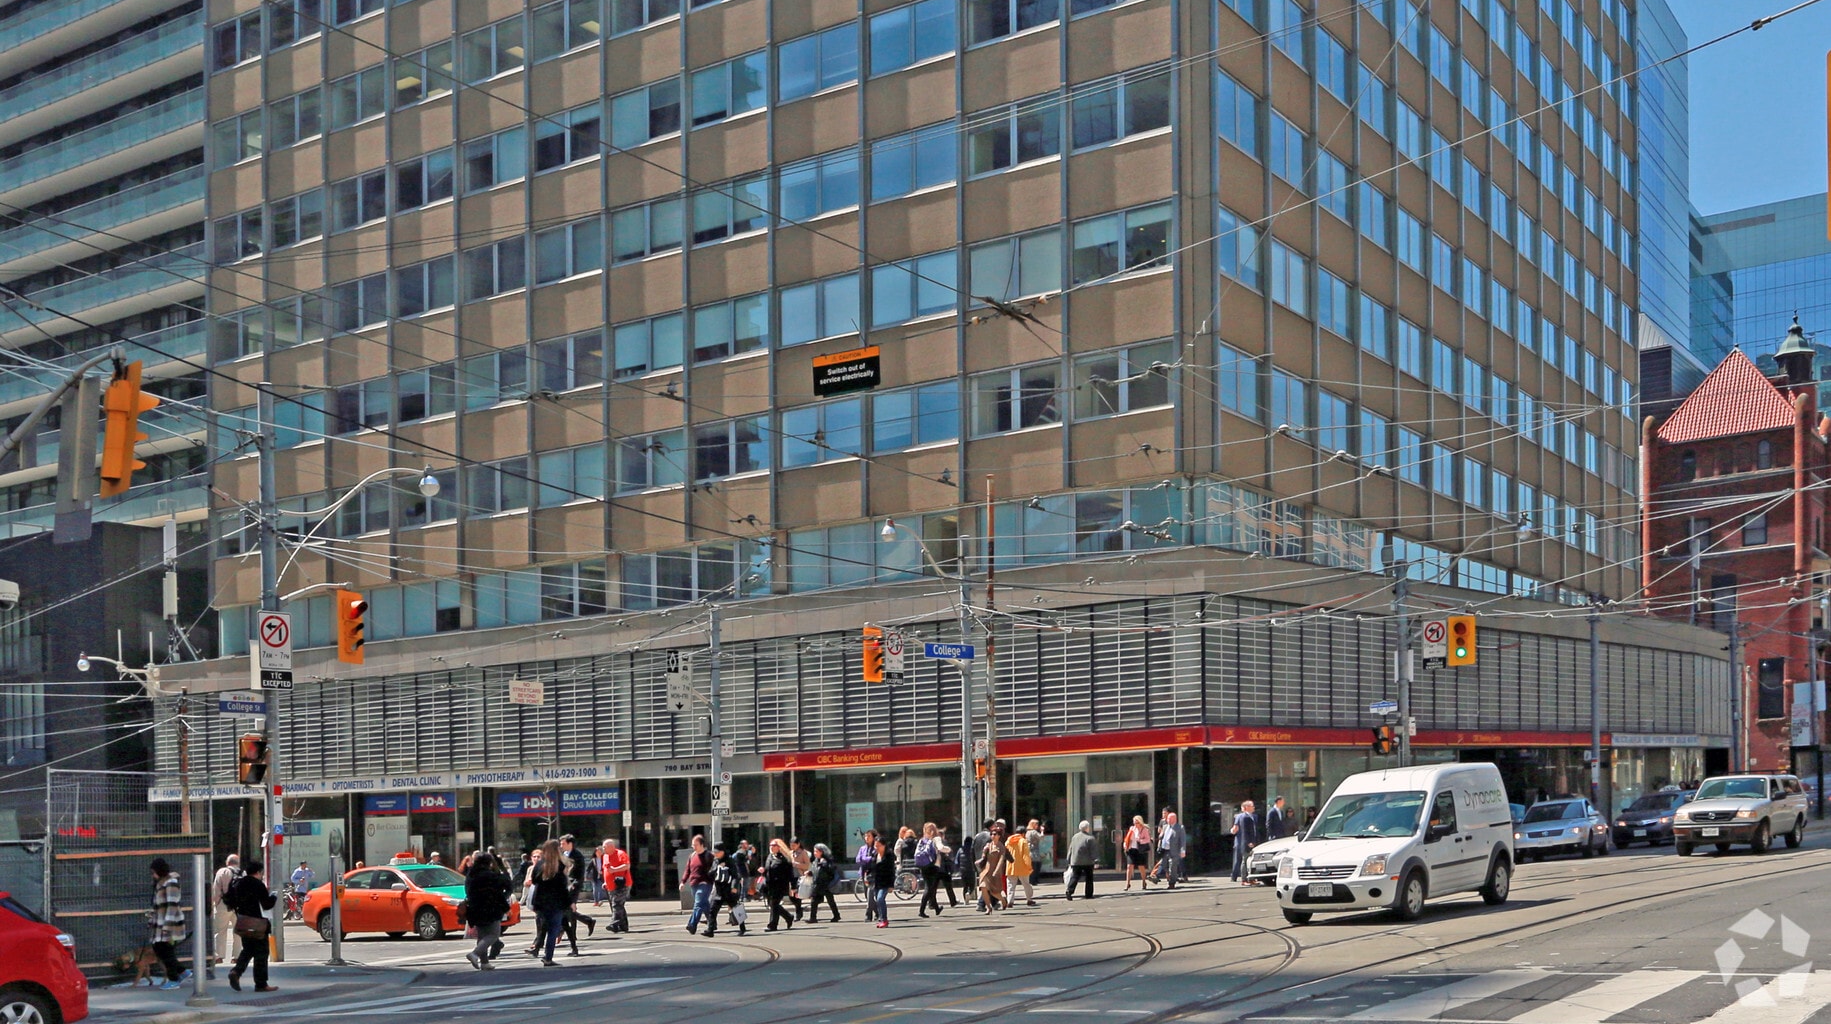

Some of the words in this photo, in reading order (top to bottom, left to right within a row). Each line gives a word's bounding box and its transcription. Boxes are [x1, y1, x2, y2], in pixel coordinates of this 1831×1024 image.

[827, 366, 847, 376] Switch
[848, 364, 858, 372] out
[859, 362, 866, 370] of
[819, 376, 840, 385] service
[842, 370, 874, 381] electrically
[933, 645, 961, 658] College
[262, 680, 292, 688] EXCEPTED
[227, 702, 254, 713] College
[833, 754, 858, 764] Banking
[860, 753, 882, 761] Centre
[467, 771, 525, 784] PHYSIOTHERAPY
[545, 767, 597, 779] 416-929-1900
[282, 783, 315, 792] PHARMACY
[332, 780, 374, 790] OPTOMETRISTS
[392, 777, 418, 788] DENTAL
[420, 776, 441, 785] CLINIC
[563, 791, 618, 801] BAY-COLLEGE
[563, 801, 584, 809] DRUG
[585, 800, 606, 808] MART
